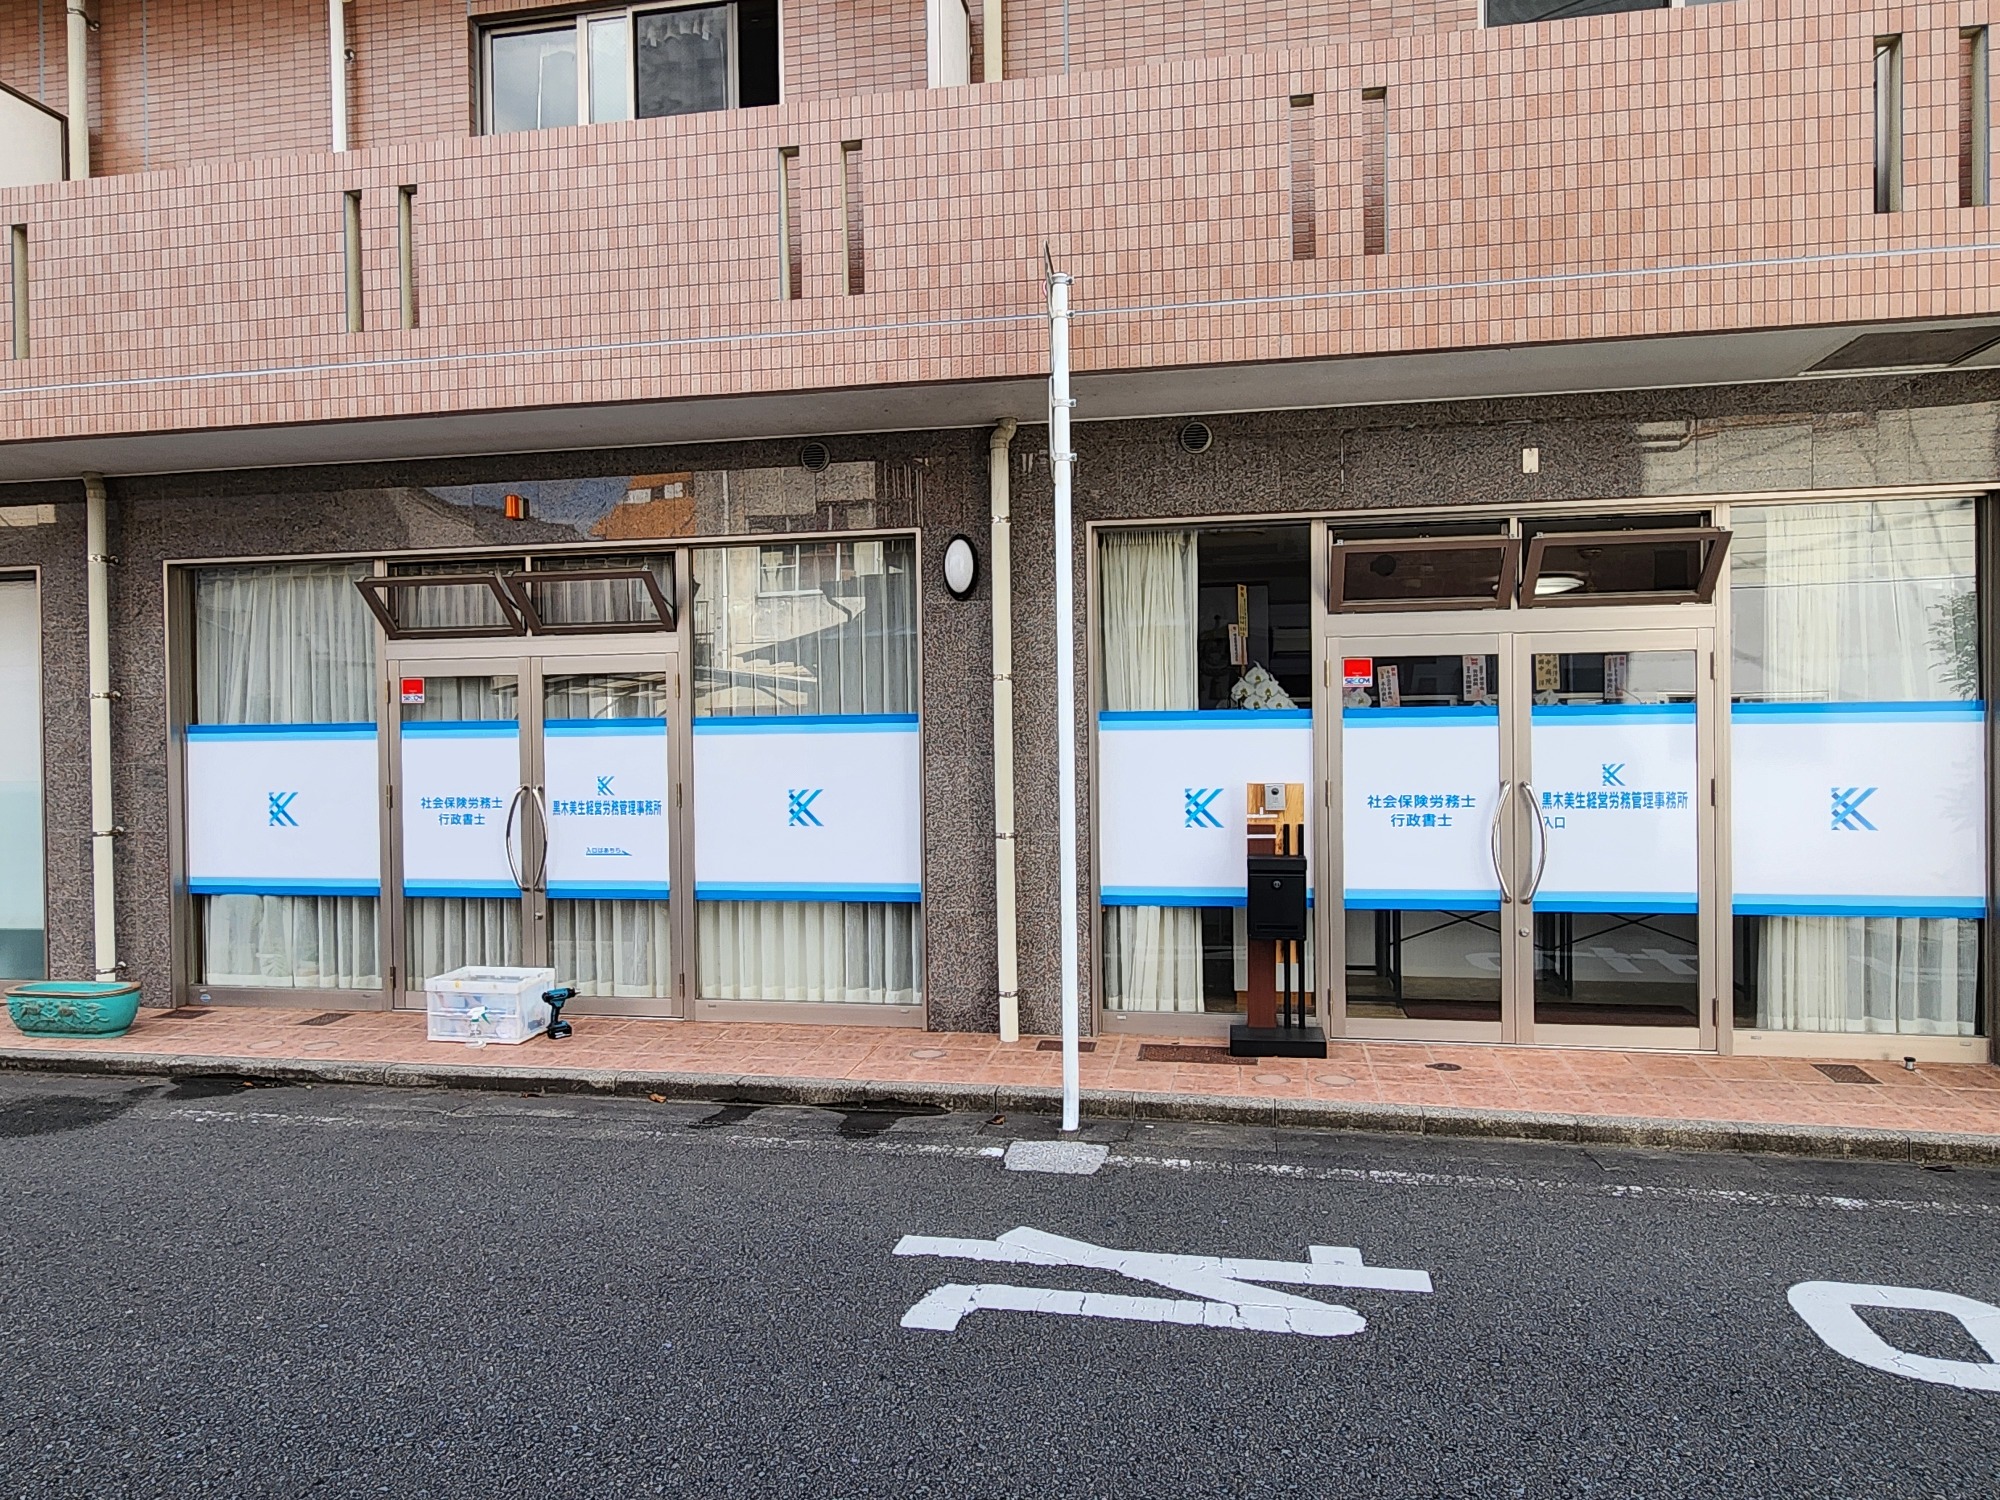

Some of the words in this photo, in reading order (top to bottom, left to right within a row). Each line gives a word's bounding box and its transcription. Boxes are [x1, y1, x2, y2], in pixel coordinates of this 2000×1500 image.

[420, 796, 503, 809] 社会保険労務士
[1367, 794, 1476, 809] 社会保険労務士
[1542, 791, 1688, 809] 黒木美生経営労務管理事務所
[553, 800, 662, 816] 黒木美生経営労務管理事務所
[438, 813, 485, 825] 行政書士
[1390, 813, 1453, 827] 行政書士
